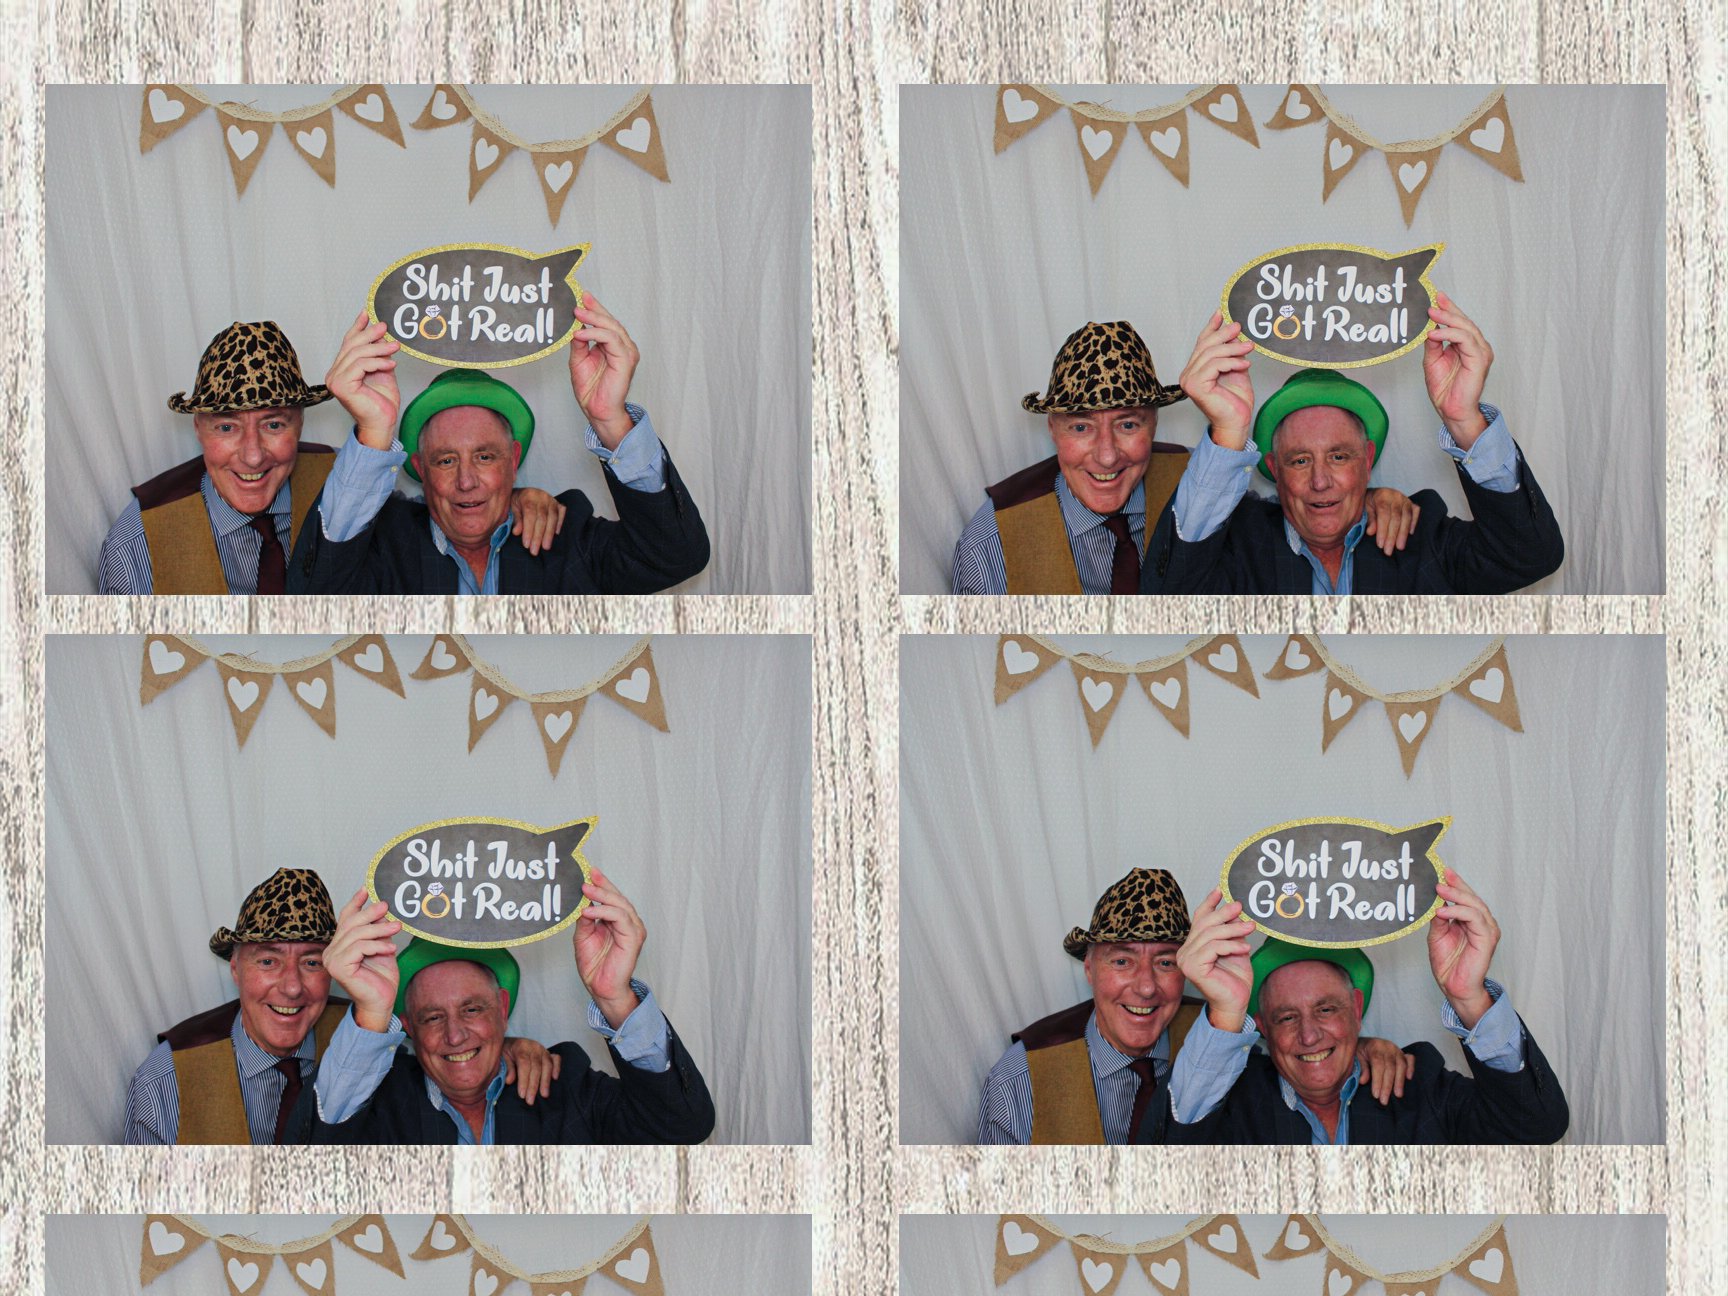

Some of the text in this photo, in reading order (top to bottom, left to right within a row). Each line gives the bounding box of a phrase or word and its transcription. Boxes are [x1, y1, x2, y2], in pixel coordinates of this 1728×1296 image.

[403, 264, 553, 304] Shit Just
[1257, 264, 1407, 304] Shit Just
[394, 303, 554, 344] Got Real!
[1248, 303, 1408, 344] Got Real!
[404, 839, 560, 880] Shit Just
[1258, 839, 1414, 880] Shit Just
[395, 881, 561, 922] Got Real!
[1249, 881, 1415, 922] Got Real!
